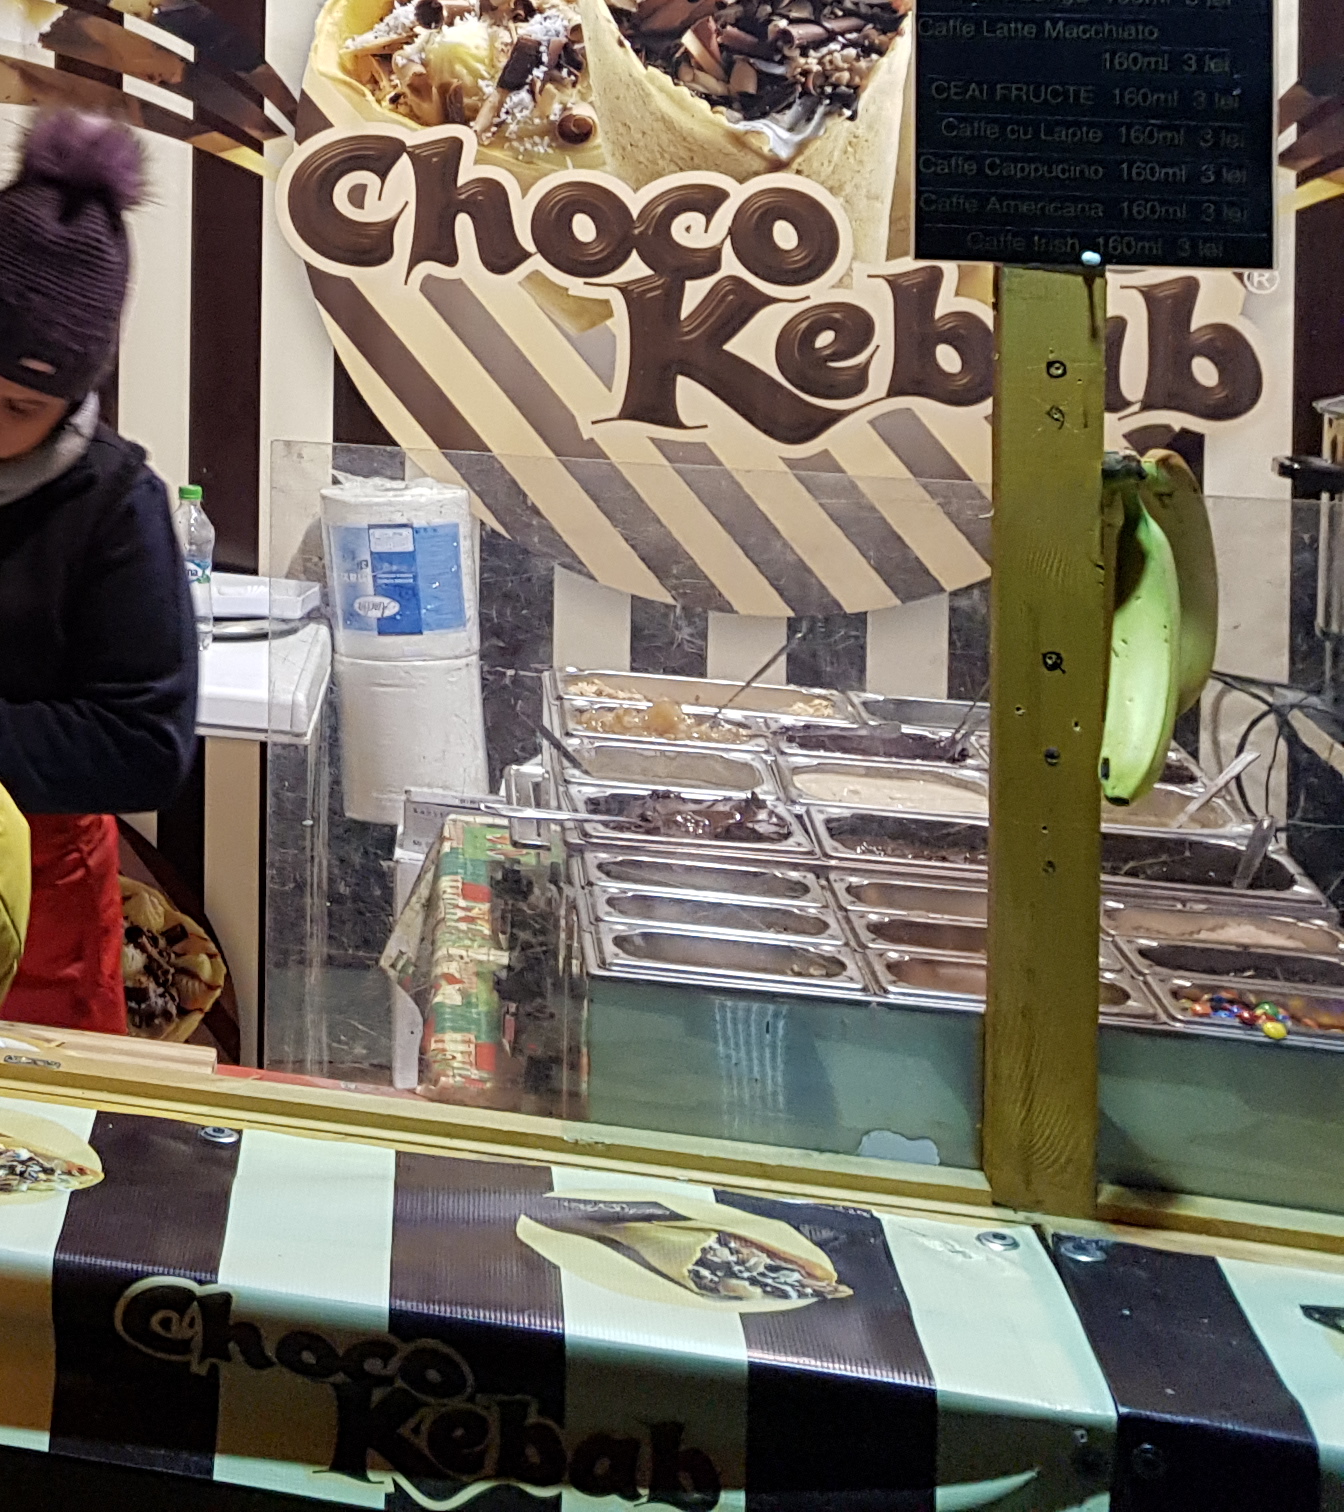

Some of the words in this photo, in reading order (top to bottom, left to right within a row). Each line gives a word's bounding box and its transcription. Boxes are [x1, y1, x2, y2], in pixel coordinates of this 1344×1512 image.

[918, 17, 975, 37] Caffe
[983, 19, 1038, 39] Latte
[1043, 20, 1160, 41] Macchiato
[1103, 51, 1169, 72] 160ml
[1182, 53, 1197, 72] 3
[931, 80, 988, 101] CEAI
[995, 83, 1096, 105] FRUCTE
[1112, 88, 1178, 108] 160ml
[1193, 89, 1207, 109] 3
[941, 118, 999, 138] Caffe
[1006, 122, 1033, 138] cu
[1040, 123, 1103, 144] Lapte
[1118, 124, 1184, 145] 160ml
[918, 156, 977, 176] Caffe
[984, 158, 1103, 181] Cappucino
[1119, 162, 1186, 182] 160ml
[284, 130, 844, 285] Choco
[918, 193, 978, 214] Caffe
[986, 196, 1104, 219] Americana
[1119, 200, 1187, 221] 160ml
[582, 263, 1265, 445] Kebb
[114, 1275, 474, 1388] Choco
[312, 1381, 722, 1511] Kebab
